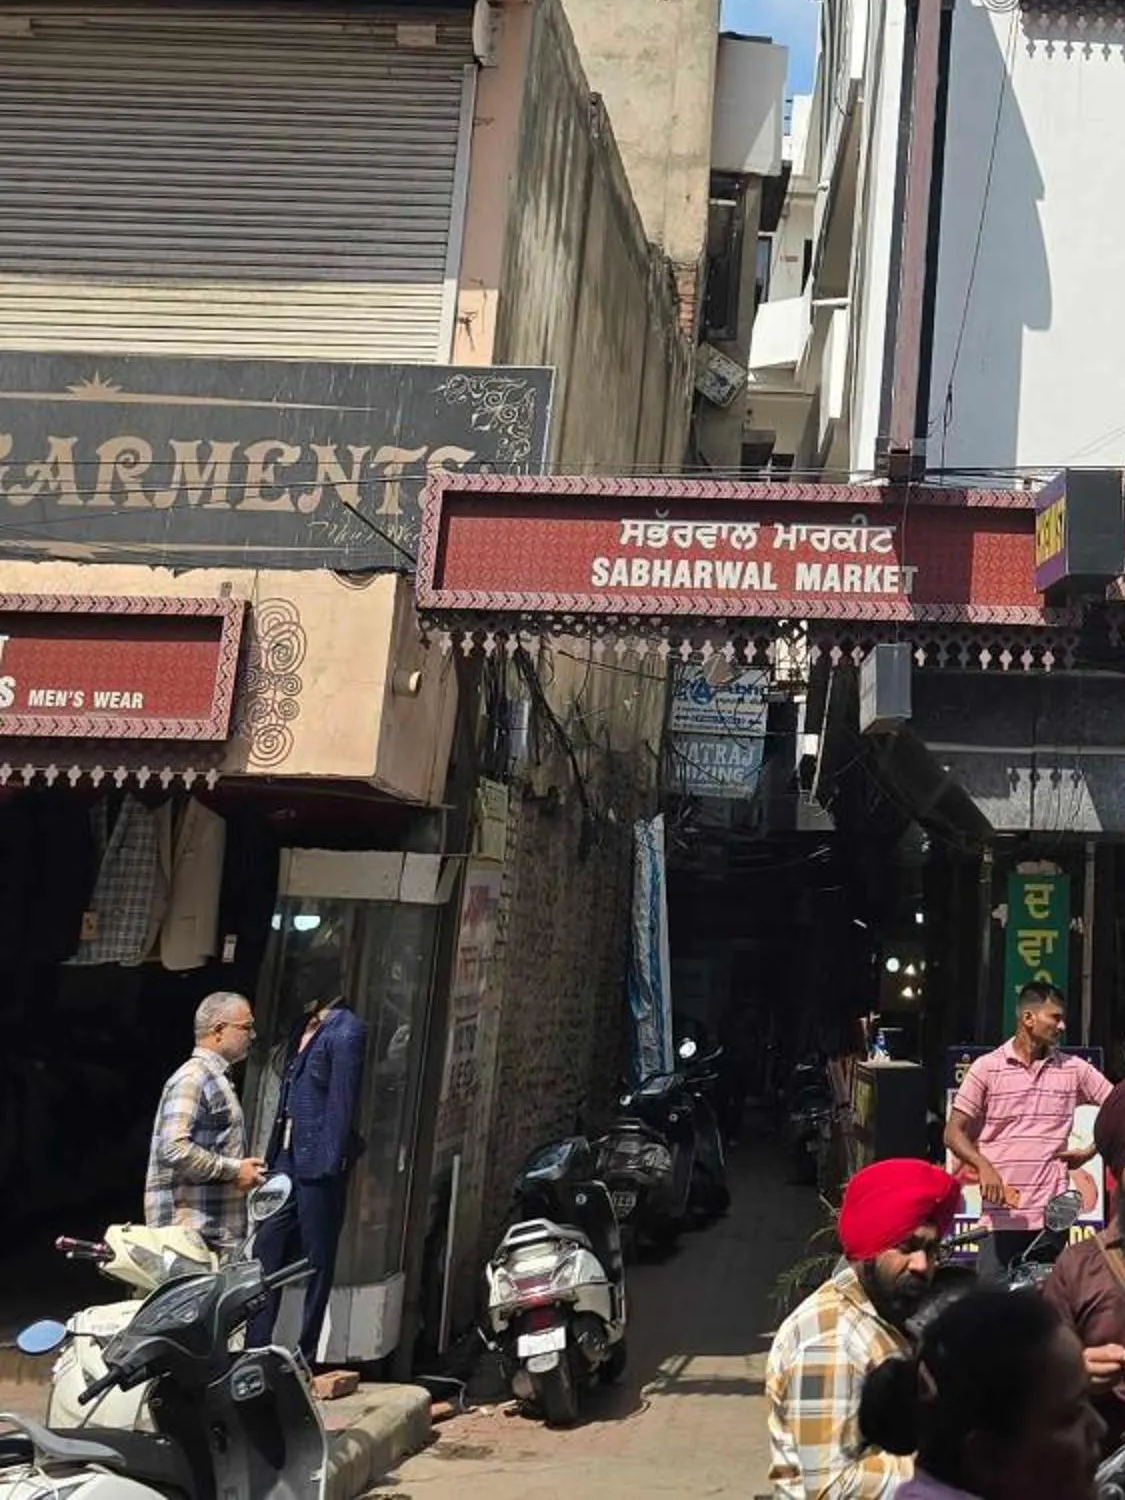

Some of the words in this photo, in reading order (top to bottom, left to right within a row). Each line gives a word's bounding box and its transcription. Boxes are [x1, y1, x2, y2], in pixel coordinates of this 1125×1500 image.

[773, 513, 897, 553] ਮਾਰਕੀਟ
[591, 557, 778, 591] SABHARWAL
[795, 562, 919, 595] MARKET
[28, 689, 85, 707] MEN'S
[94, 691, 144, 708] WEAR
